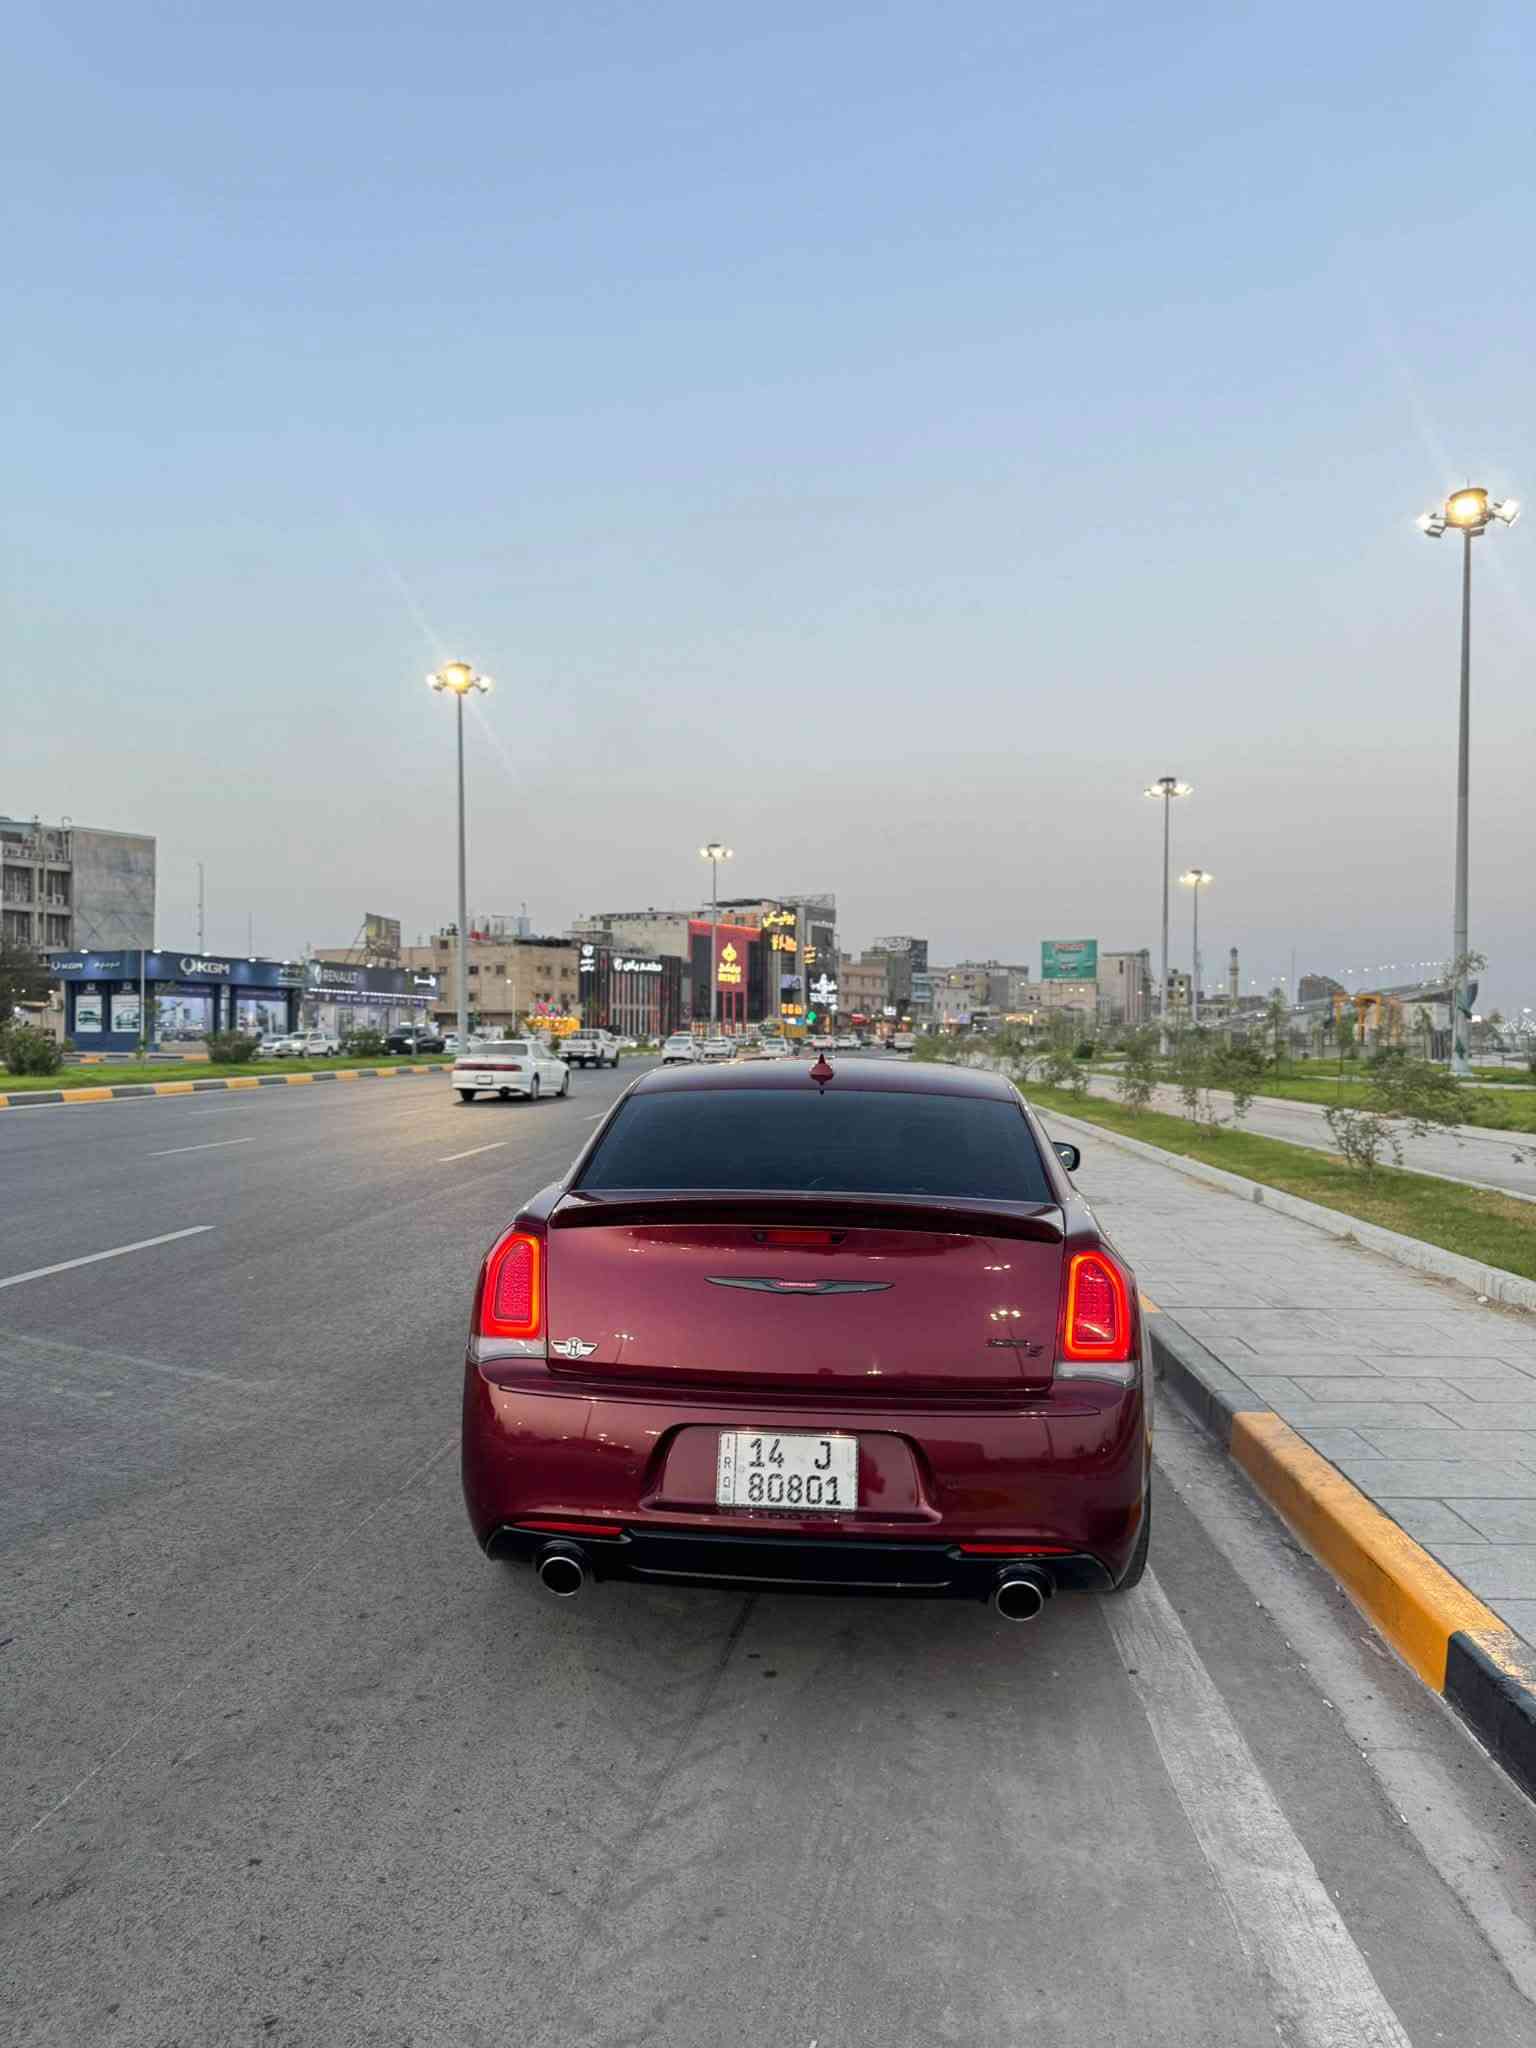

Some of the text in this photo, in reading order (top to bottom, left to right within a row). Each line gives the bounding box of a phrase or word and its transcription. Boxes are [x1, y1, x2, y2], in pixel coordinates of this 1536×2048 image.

[197, 961, 230, 975] KGM
[322, 968, 358, 984] RENAULT
[749, 1438, 832, 1470] 14 J
[747, 1472, 841, 1505] 80801
